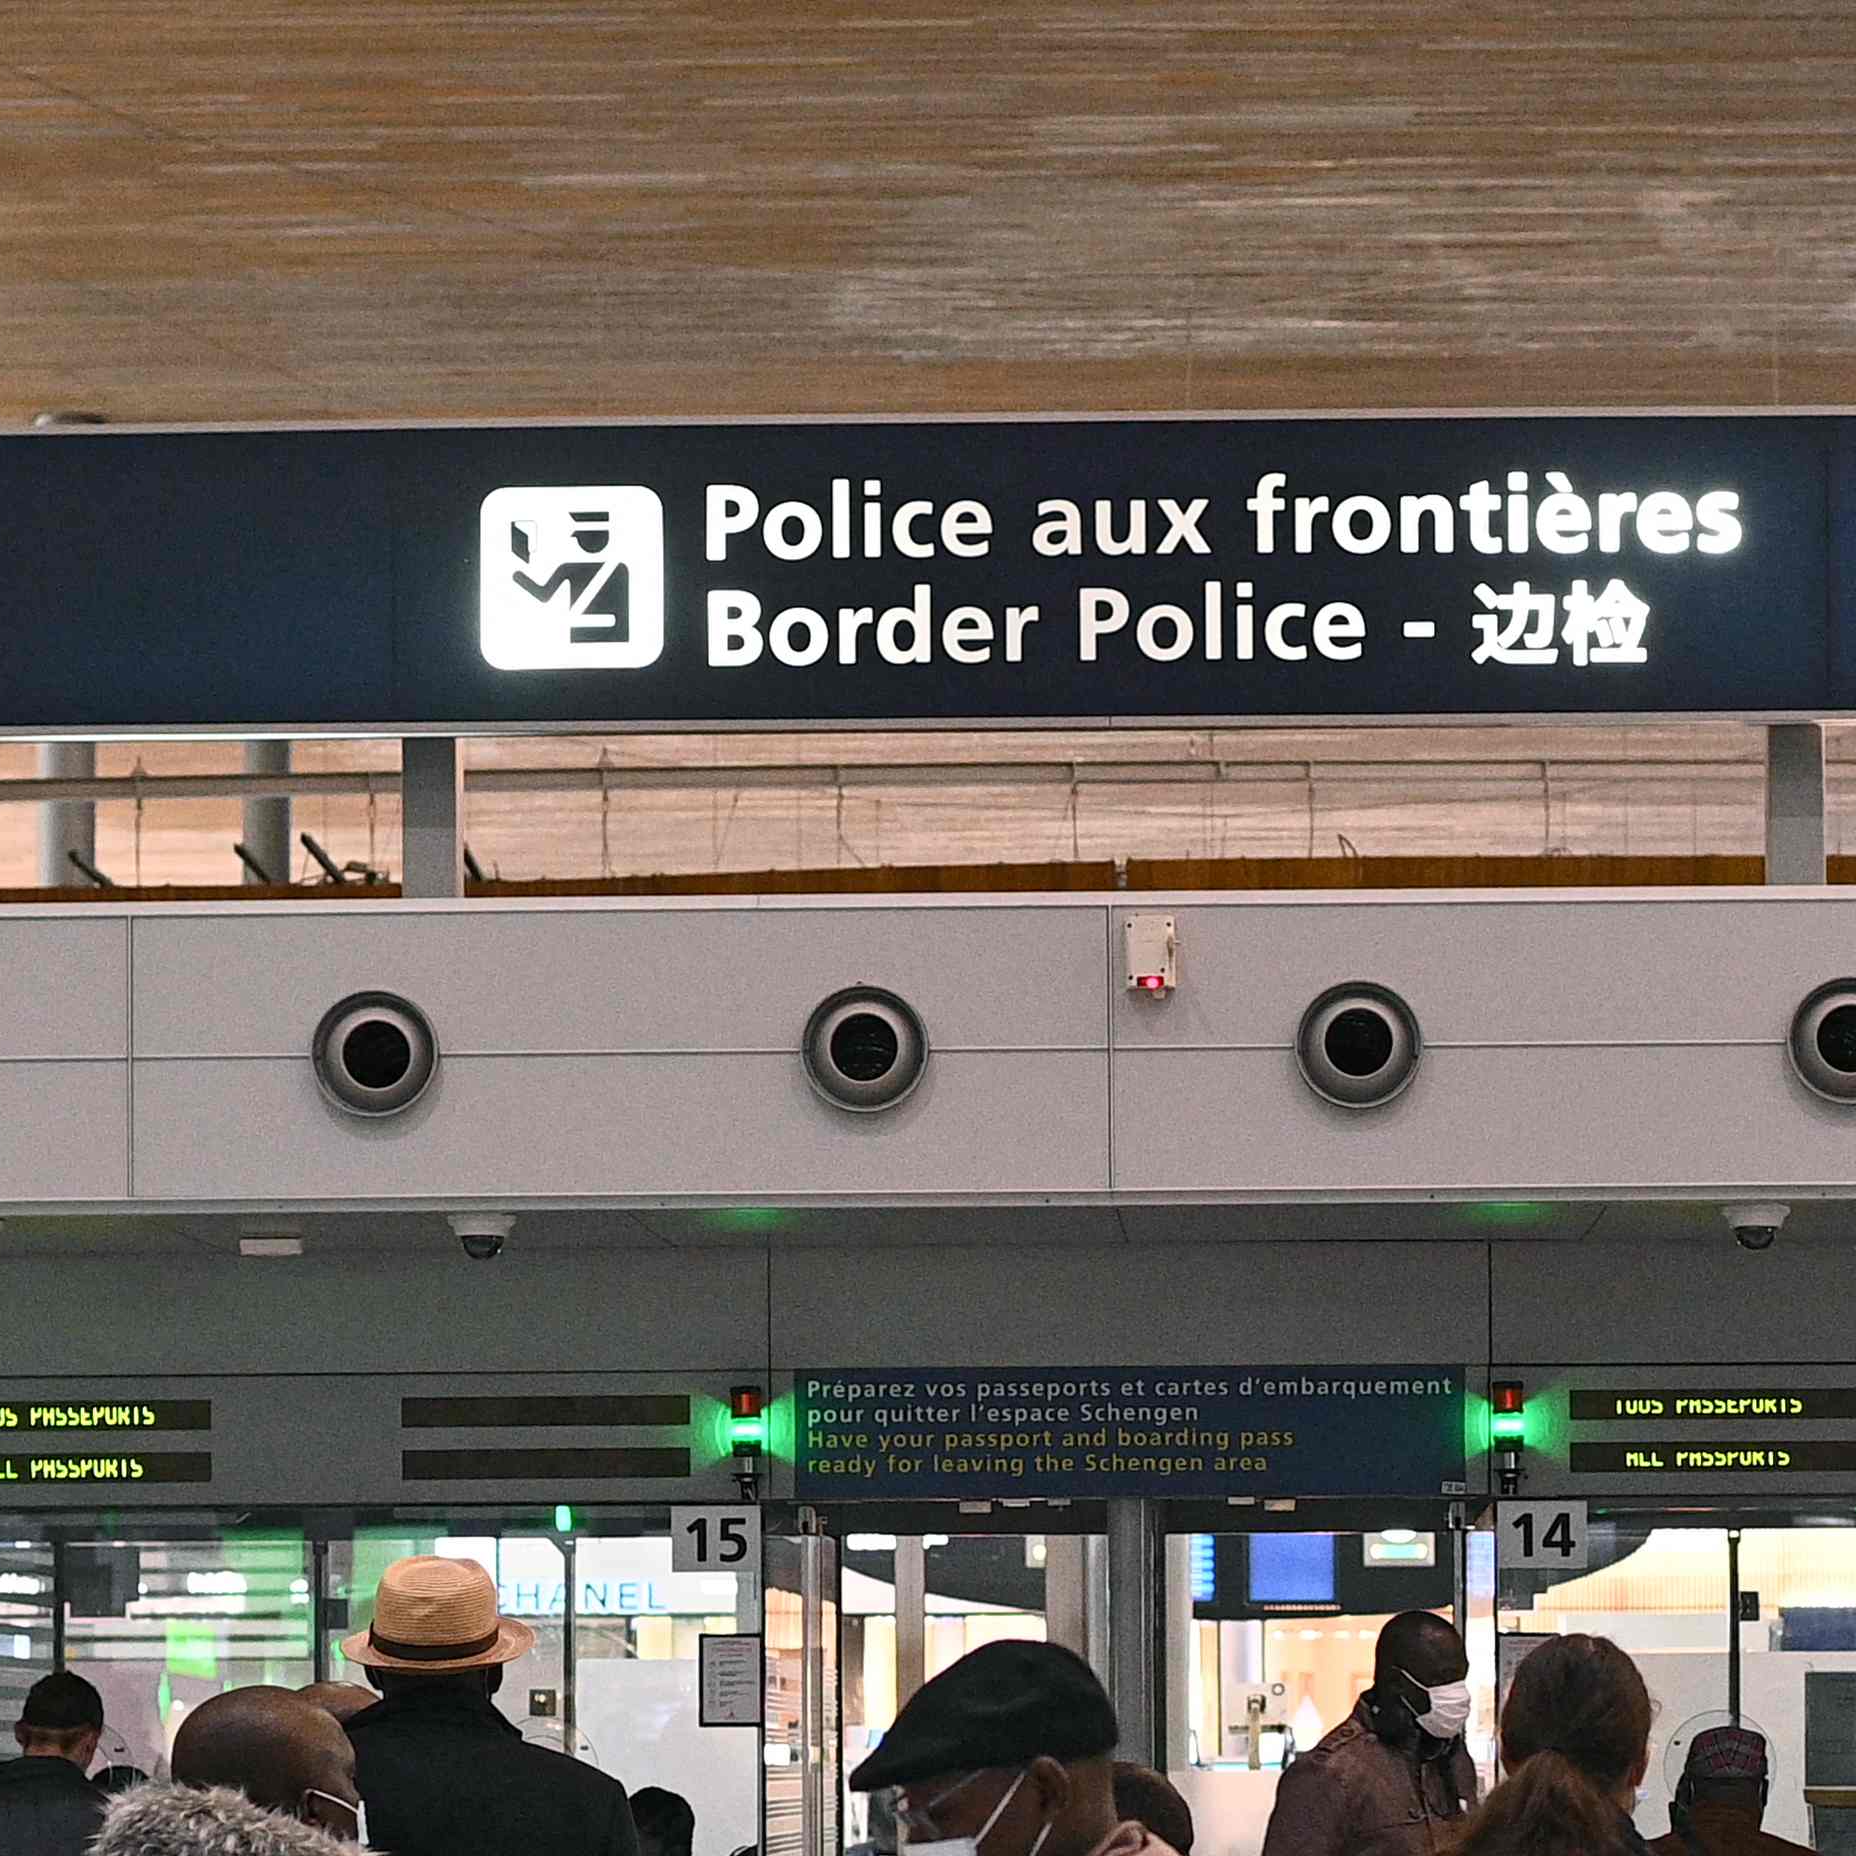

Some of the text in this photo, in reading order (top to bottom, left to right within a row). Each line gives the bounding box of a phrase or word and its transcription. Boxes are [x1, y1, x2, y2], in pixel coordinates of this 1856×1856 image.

[707, 472, 1742, 560] Police aux frontières
[708, 579, 1650, 666] Border Police - 边检
[807, 1379, 916, 1401] Préparez
[926, 1382, 967, 1397] vos
[977, 1379, 1110, 1400] passeports
[1121, 1379, 1144, 1395] et
[1155, 1378, 1229, 1395] cartes
[808, 1408, 864, 1426] pour
[875, 1404, 960, 1426] quitter
[1081, 1402, 1198, 1424] Schengen
[808, 1427, 1295, 1450] Have your passport and boarding pass
[808, 1452, 1268, 1475] ready for leaving the Schengen area
[687, 1518, 747, 1562] 15
[1512, 1513, 1575, 1557] 14
